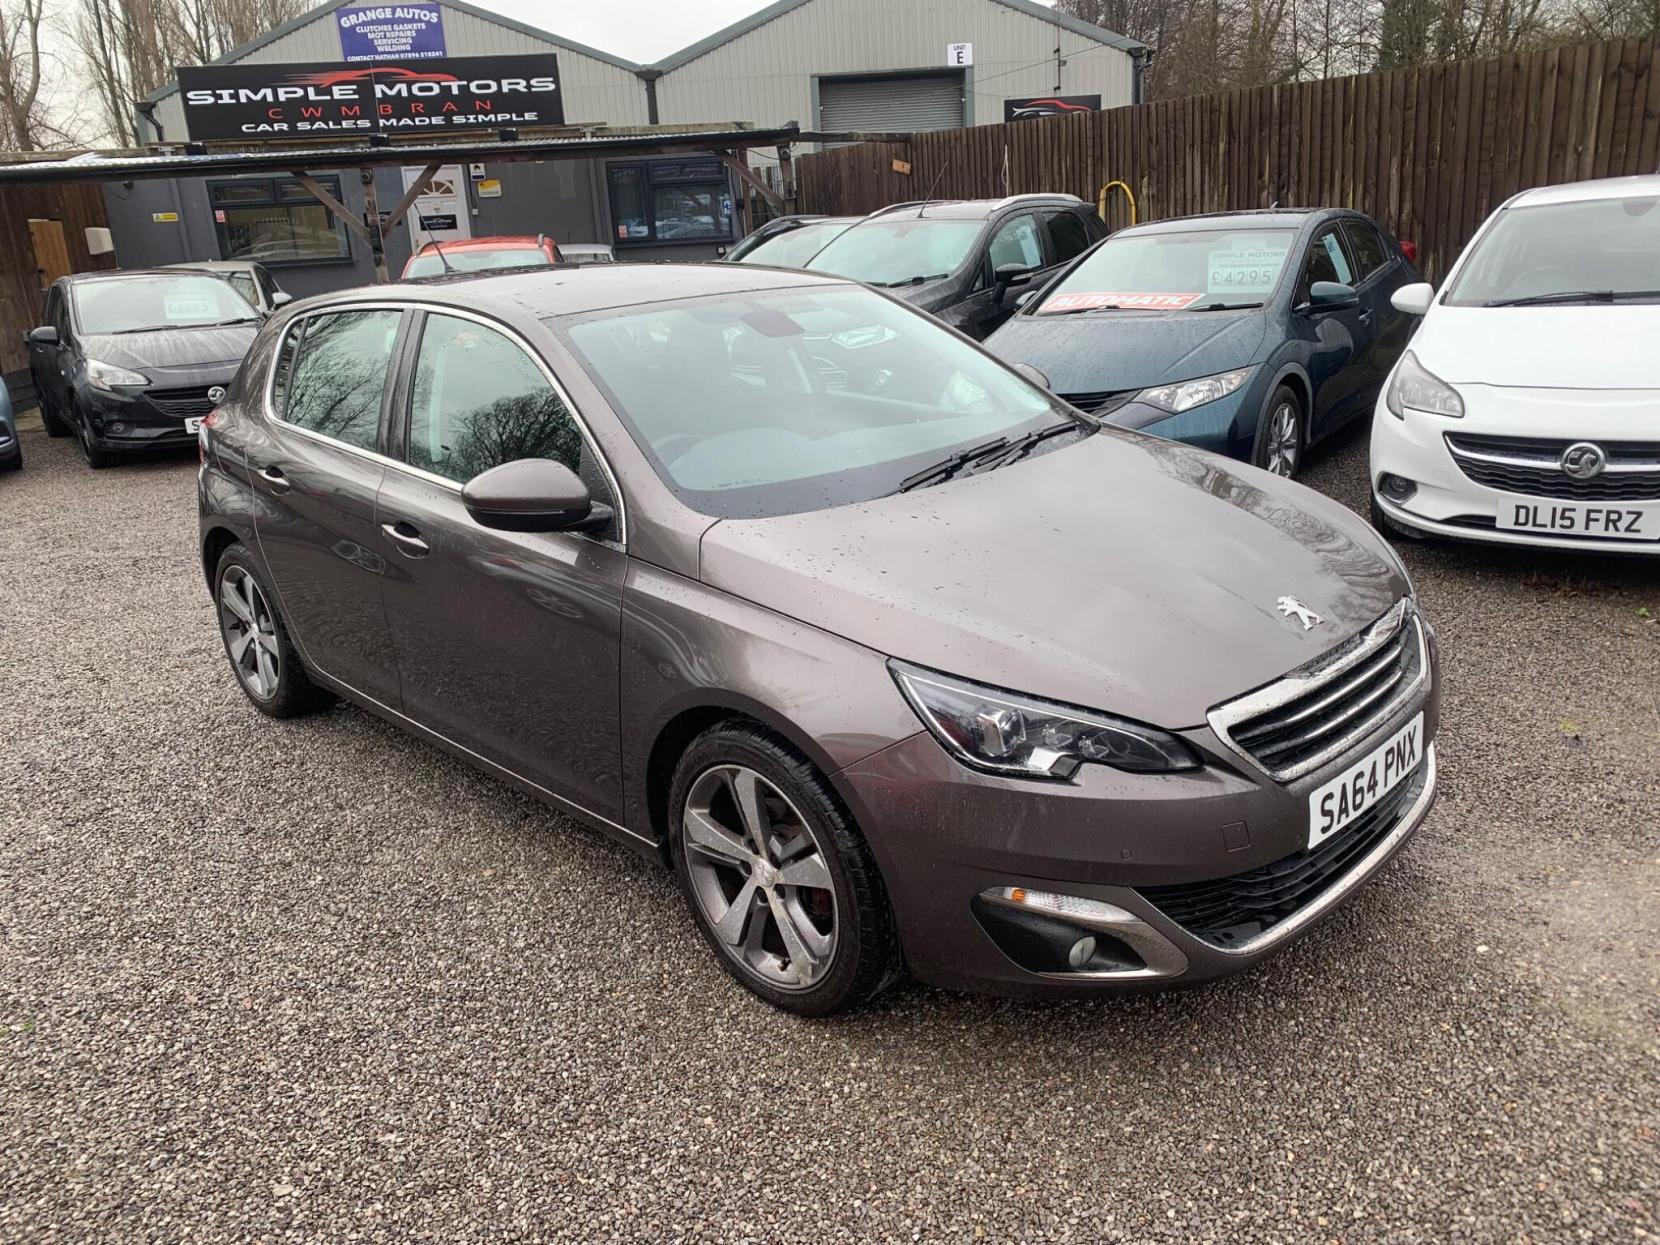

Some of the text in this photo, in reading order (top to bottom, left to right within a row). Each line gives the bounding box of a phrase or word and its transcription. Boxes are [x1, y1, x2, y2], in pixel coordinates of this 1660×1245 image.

[340, 8, 438, 27] GRANGE AUTOS
[356, 25, 392, 33] CLUTCHES
[374, 37, 412, 45] SERVICING
[376, 44, 411, 52] WELDING
[957, 51, 964, 64] E
[186, 77, 555, 105] SIMPLE MOTORS
[268, 100, 491, 119] CWMBRAN
[241, 112, 538, 132] CAR SALES MADE SIMPLE
[1212, 270, 1271, 285] £4295
[1055, 295, 1188, 307] AUTOMATIC
[1513, 504, 1643, 533] DL15 FRZ
[1320, 725, 1417, 835] SA64 PNX
